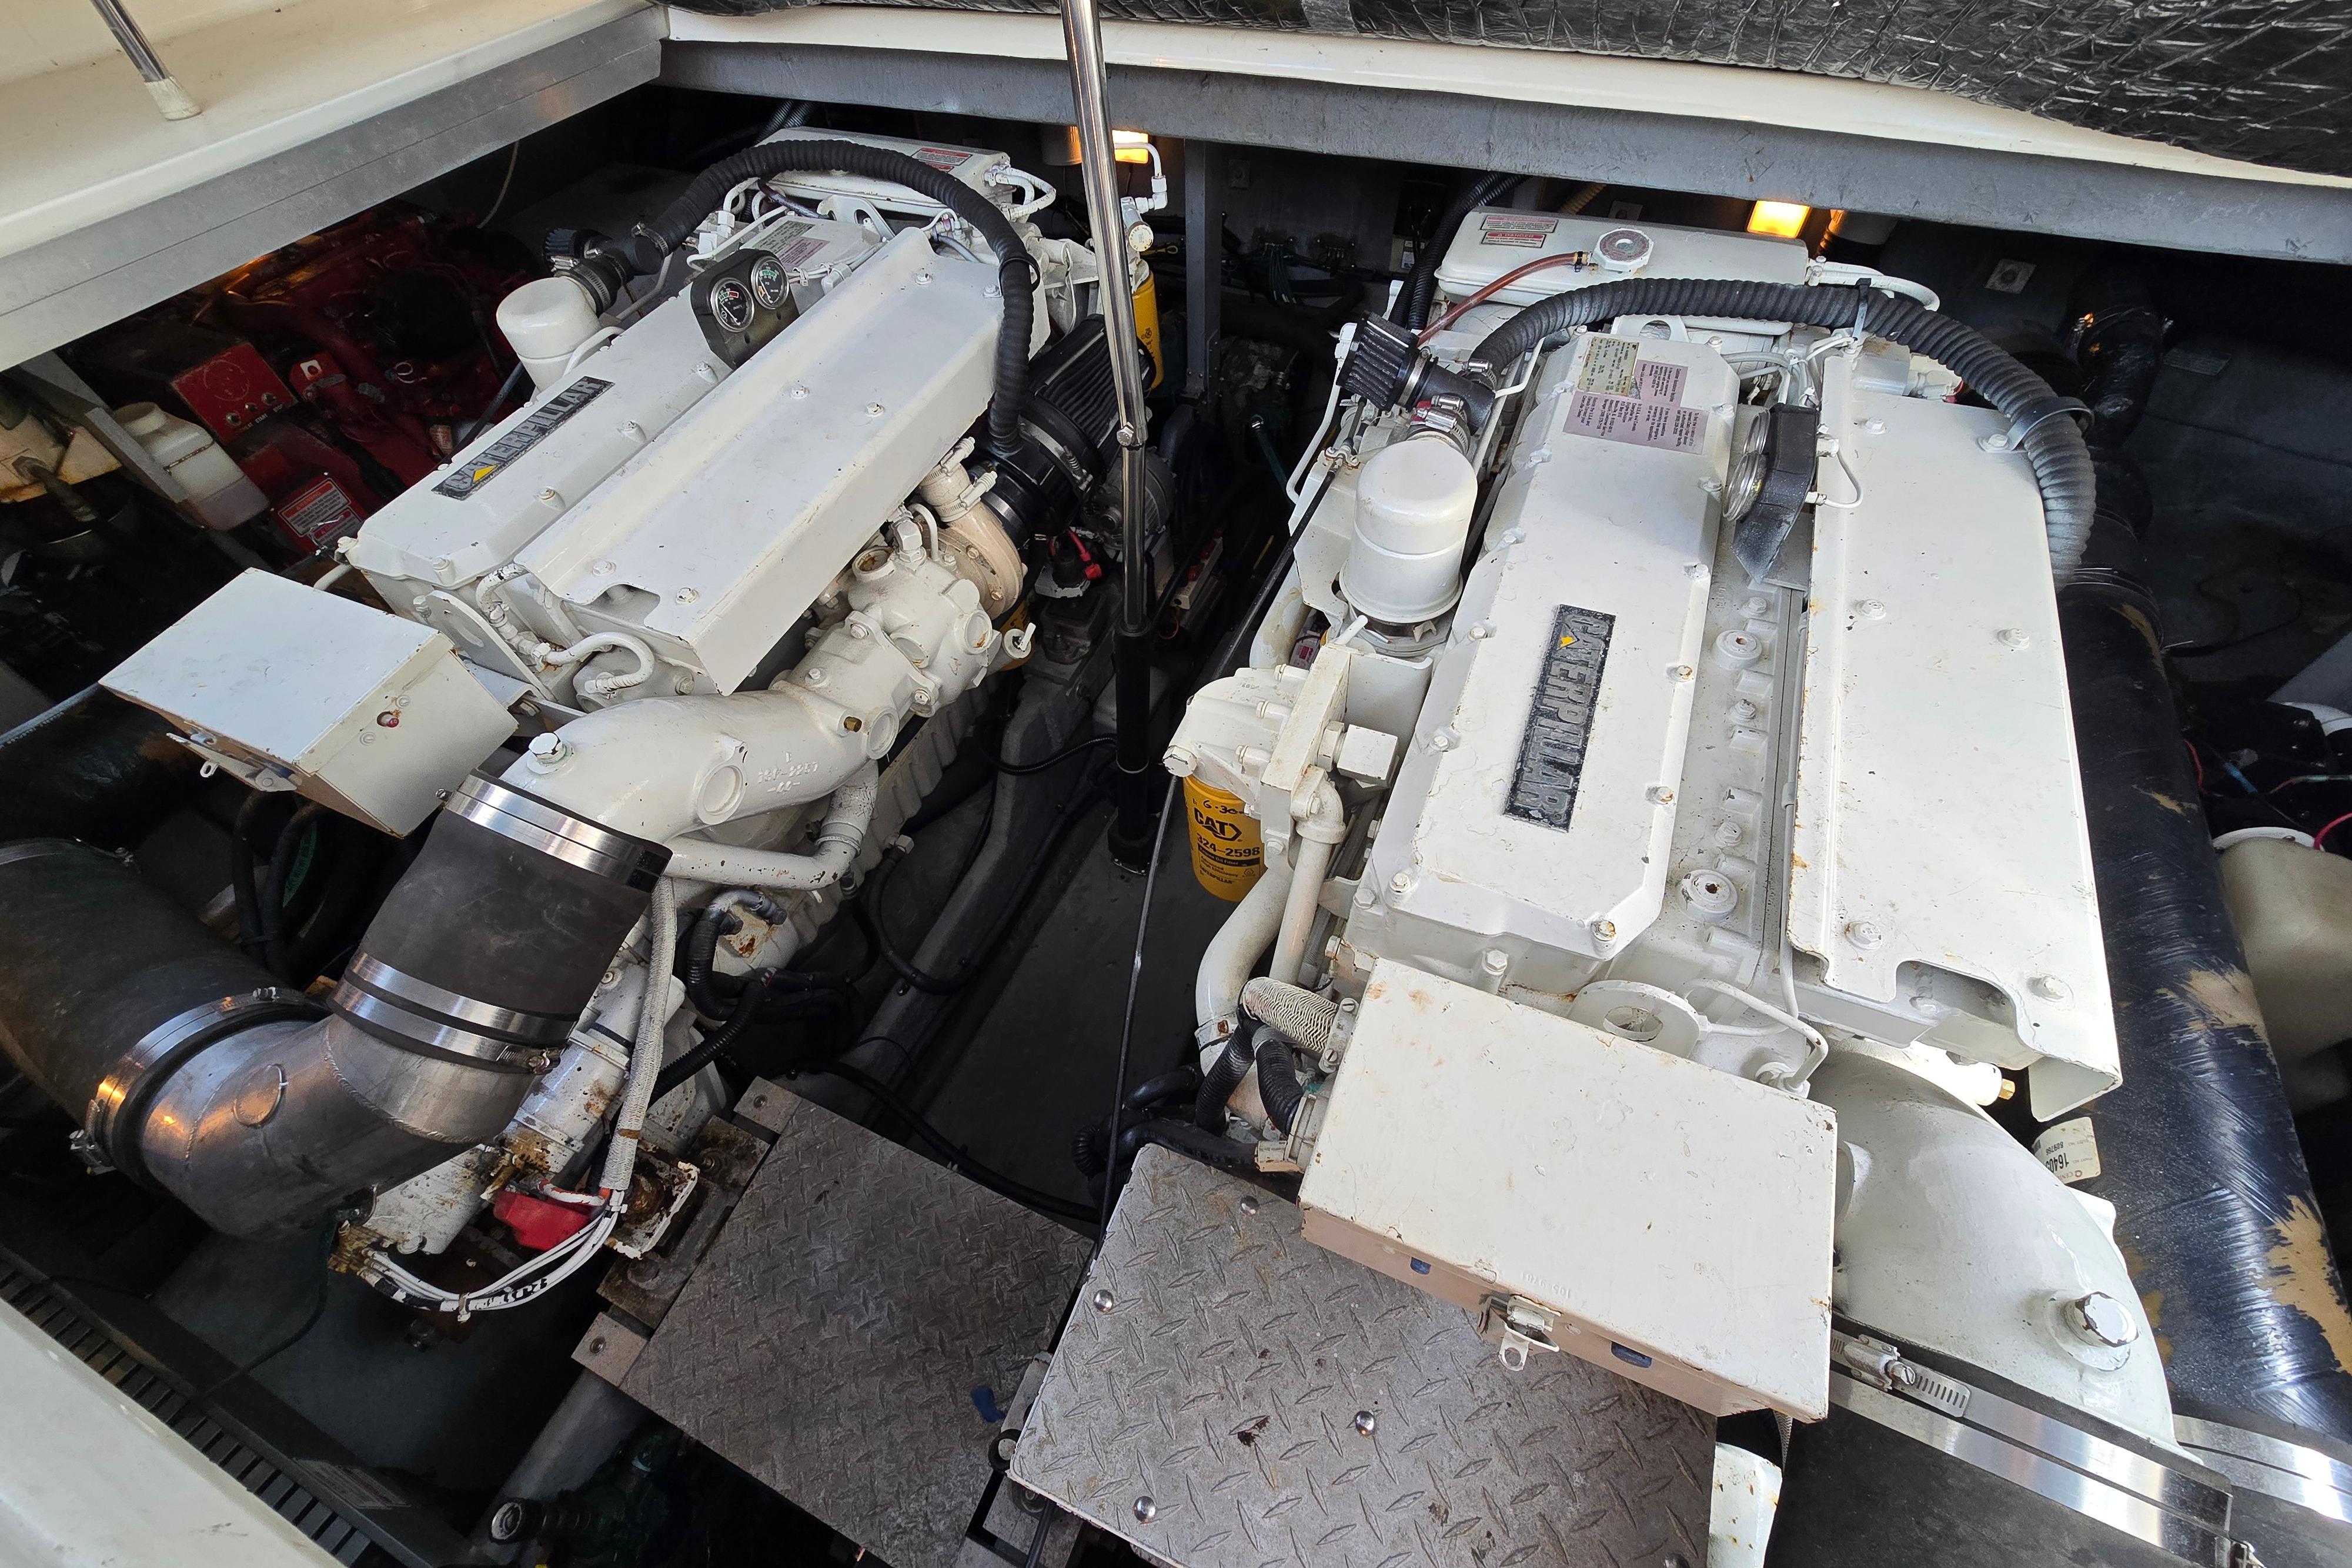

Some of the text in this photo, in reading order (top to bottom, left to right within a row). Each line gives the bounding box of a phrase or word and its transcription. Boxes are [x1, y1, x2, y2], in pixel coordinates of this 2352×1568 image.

[443, 380, 602, 490] CATERPILLAR
[1194, 807, 1232, 840] CAT
[1197, 833, 1260, 857] 324-2598
